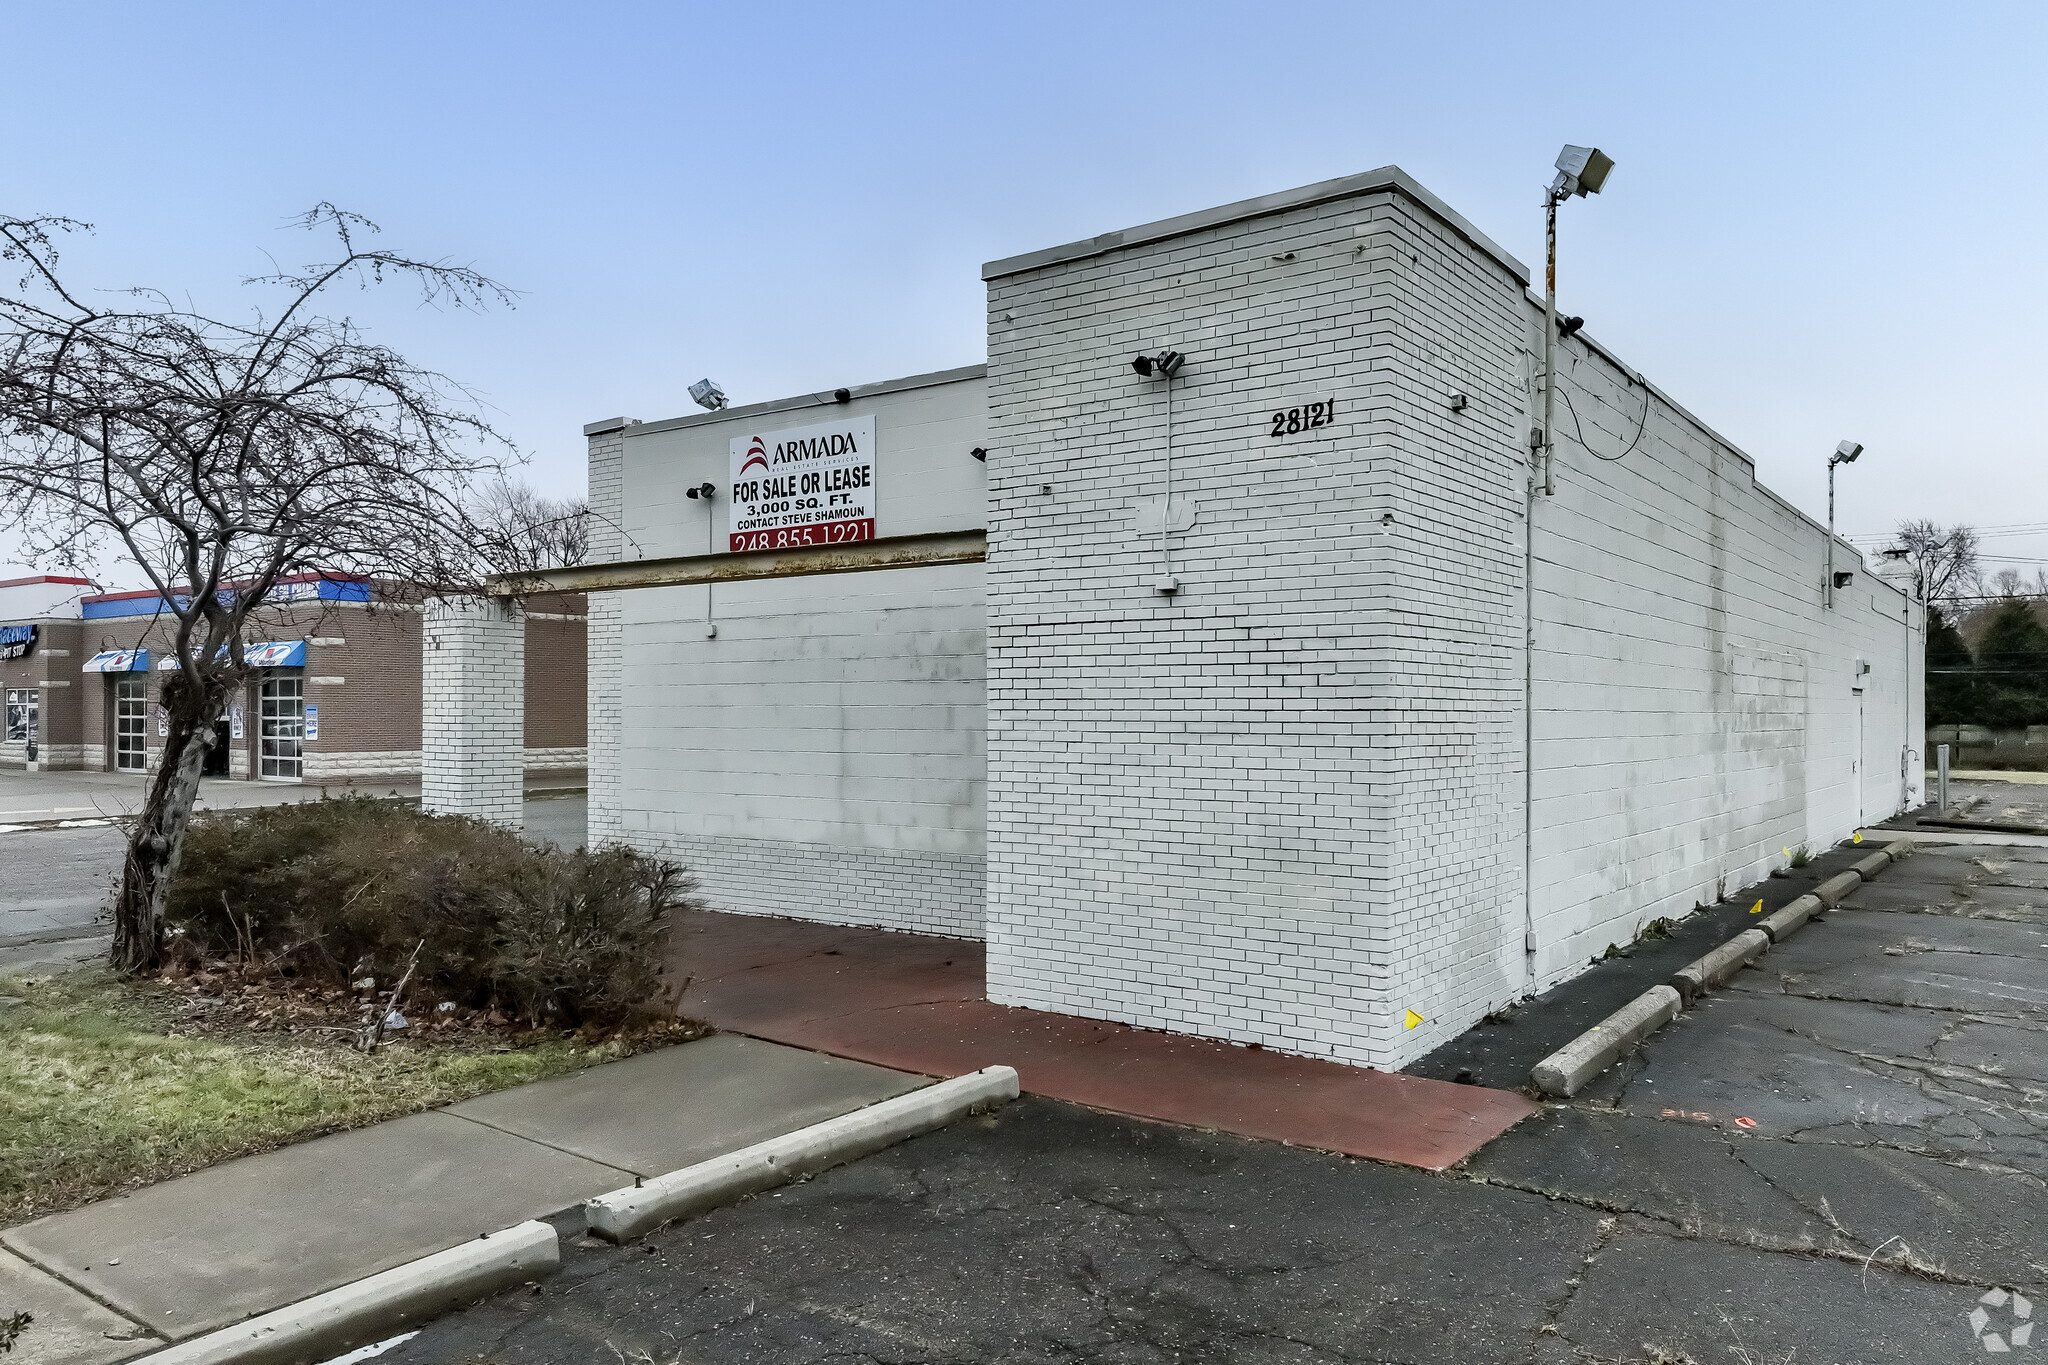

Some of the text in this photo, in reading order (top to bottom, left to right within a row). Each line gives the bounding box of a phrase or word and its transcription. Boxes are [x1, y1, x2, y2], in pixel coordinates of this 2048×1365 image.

[1271, 397, 1334, 438] 28121
[773, 432, 858, 465] ARMADA
[793, 461, 819, 470] ESTATE
[823, 456, 859, 466] SERVICES
[733, 465, 871, 504] FOR SALE OR LEASE
[737, 506, 865, 530] CONTACT STEVE SHAMOUN
[747, 493, 853, 518] 3,000 SQ. FT.
[735, 521, 869, 551] 248 855 1221
[0, 624, 32, 645] aceway
